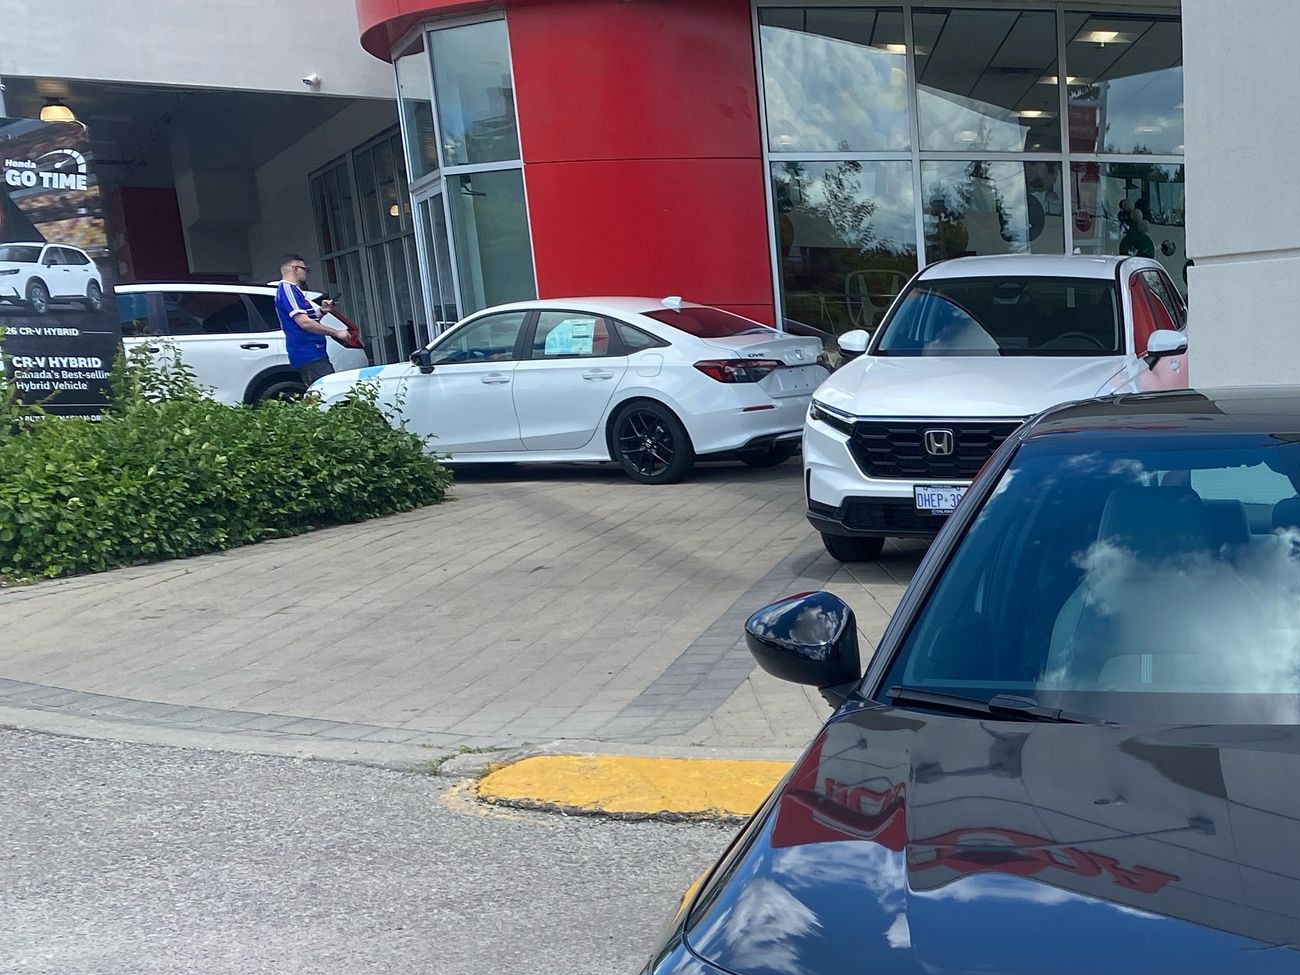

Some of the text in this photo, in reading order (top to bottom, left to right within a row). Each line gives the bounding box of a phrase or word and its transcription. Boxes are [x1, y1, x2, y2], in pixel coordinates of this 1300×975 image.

[5, 159, 36, 168] Honda
[5, 169, 87, 191] GO TIME
[19, 327, 41, 335] CR-V
[44, 328, 79, 336] HYBRID
[12, 356, 102, 368] CR-V HYBRID
[16, 381, 50, 392] Hybrid
